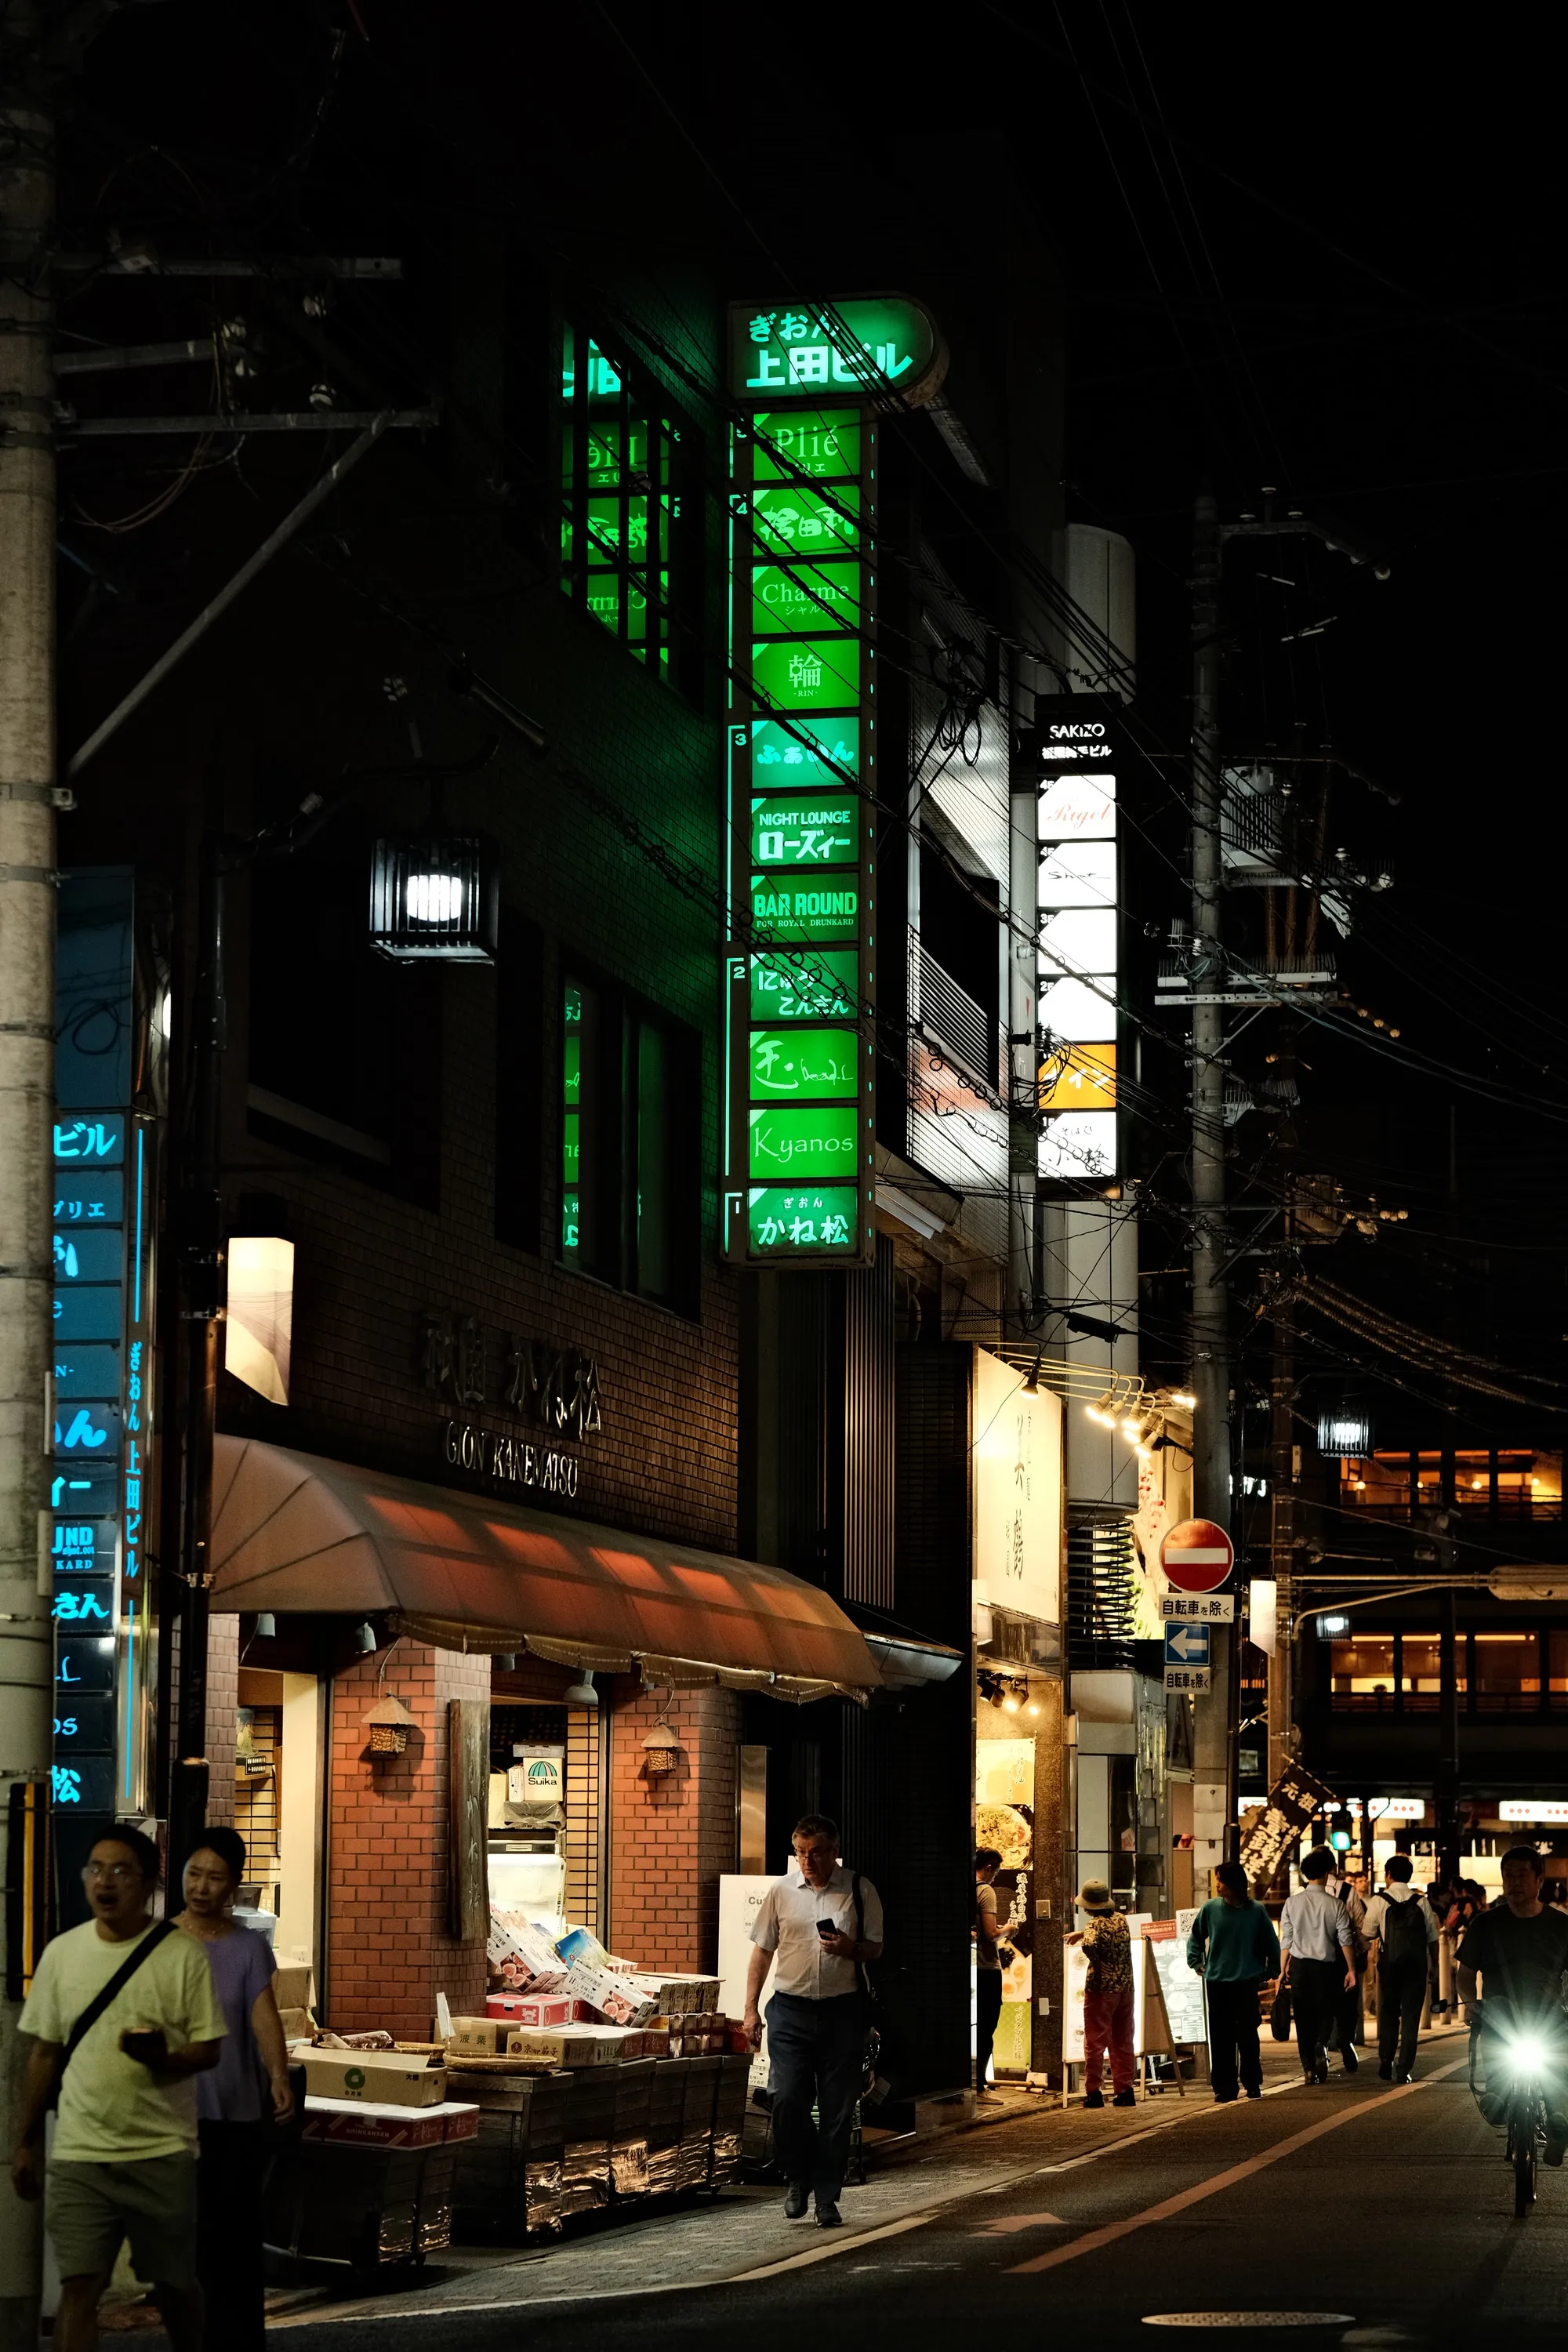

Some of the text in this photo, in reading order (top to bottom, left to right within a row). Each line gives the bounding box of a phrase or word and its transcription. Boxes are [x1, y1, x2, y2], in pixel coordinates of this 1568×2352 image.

[749, 311, 839, 343] ぎおん
[746, 342, 913, 387] 上田ビル
[775, 426, 838, 457] Plié
[762, 583, 849, 604] Charme
[786, 605, 826, 615] シャル
[789, 654, 822, 688] 輪
[1049, 723, 1105, 739] SAKIZO
[735, 734, 746, 746] 3
[759, 810, 850, 826] NIGHT LOUNGE
[754, 892, 857, 917] BAR ROUND
[778, 919, 805, 927] ROYAL
[810, 918, 854, 927] DRUNKARD
[733, 967, 746, 978] 2
[754, 1127, 854, 1163] Kyanos
[783, 1197, 823, 1209] ぎおん
[757, 1214, 849, 1245] かね松
[445, 1421, 579, 1498] GION KANEMATSU
[1162, 1599, 1230, 1617] 自転車を除く
[1167, 1672, 1209, 1689] 自転車を除く
[528, 1777, 557, 1786] Suika
[748, 1896, 766, 1905] Cu
